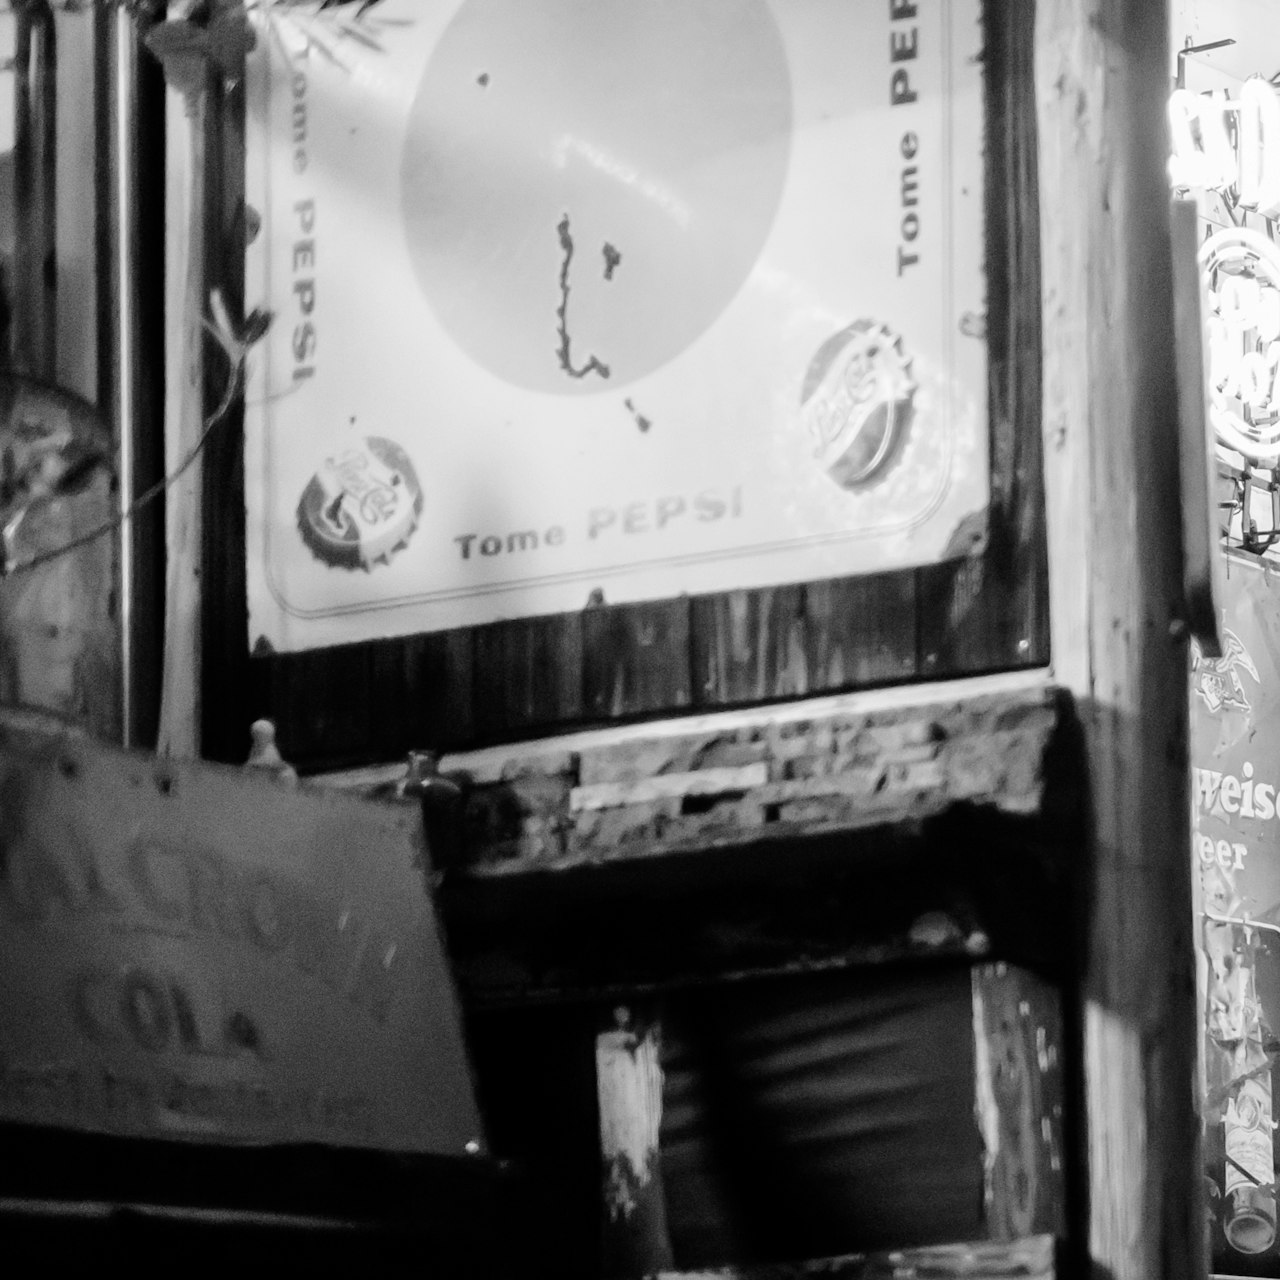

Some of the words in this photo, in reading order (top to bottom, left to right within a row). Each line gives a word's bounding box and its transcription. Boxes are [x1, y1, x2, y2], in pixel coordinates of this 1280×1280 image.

[897, 128, 920, 279] Tome
[292, 198, 317, 382] PEPSI
[452, 524, 566, 562] Tome
[586, 484, 743, 541] PEPSI
